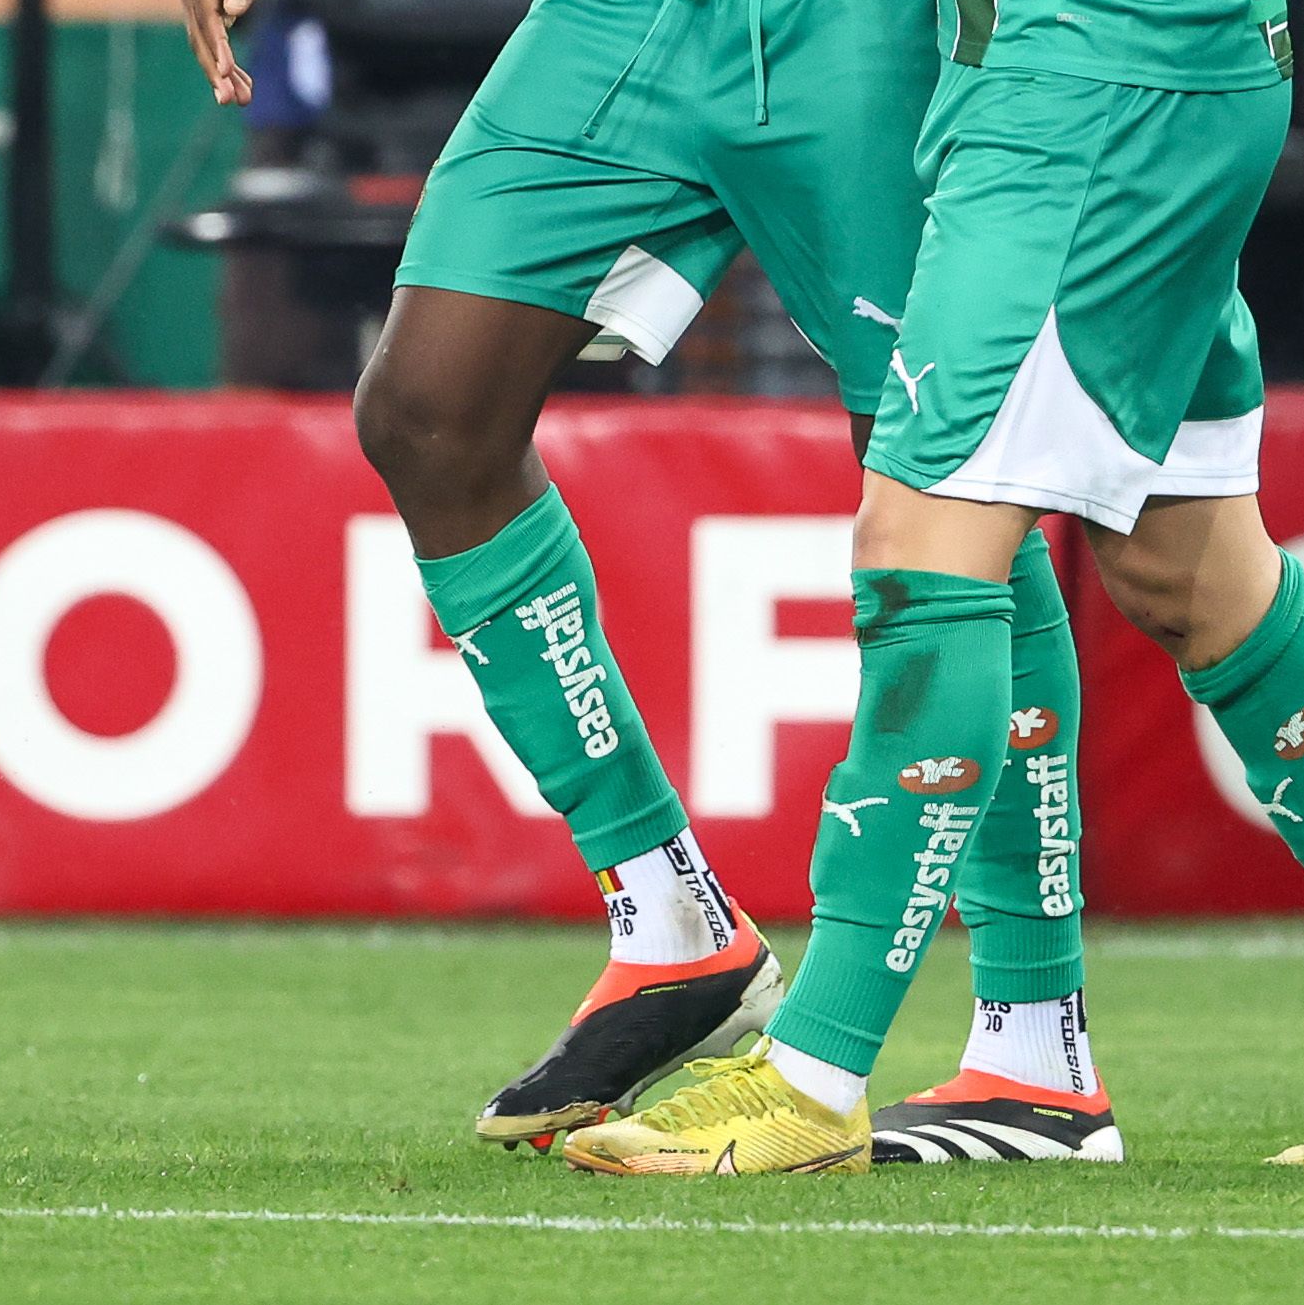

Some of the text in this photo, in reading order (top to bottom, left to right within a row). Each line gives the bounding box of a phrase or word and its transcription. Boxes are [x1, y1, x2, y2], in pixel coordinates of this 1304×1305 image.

[514, 581, 620, 760] easystaff
[885, 802, 980, 974] easystaff
[1026, 753, 1076, 917] easystaff
